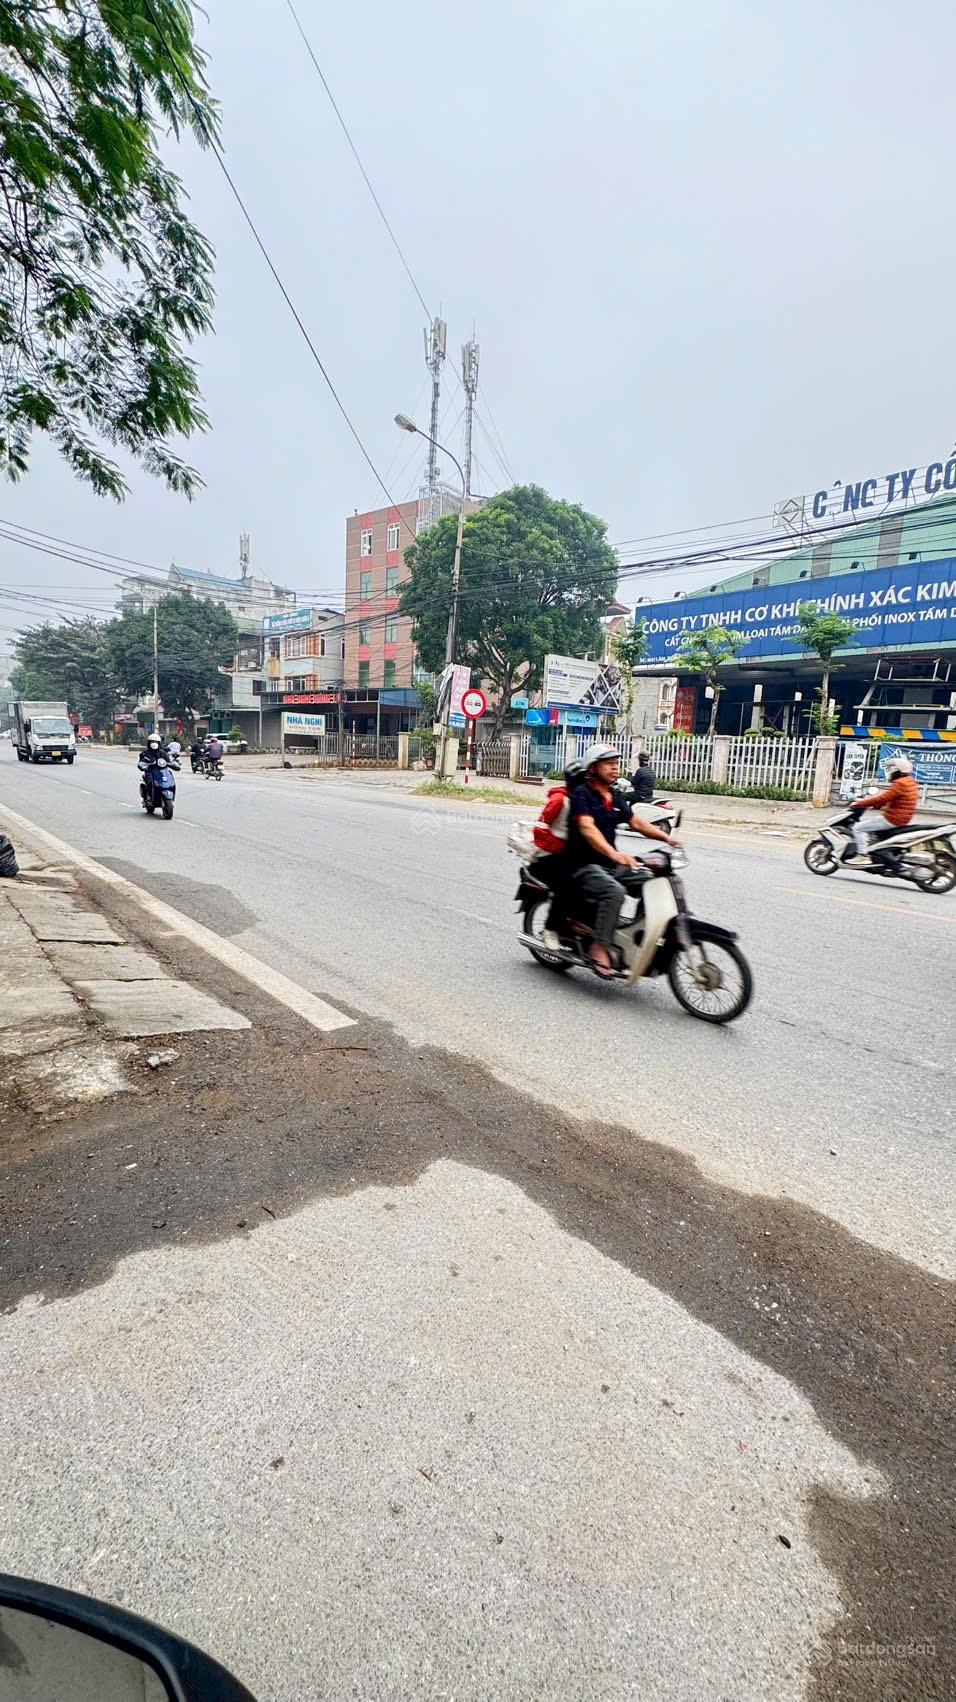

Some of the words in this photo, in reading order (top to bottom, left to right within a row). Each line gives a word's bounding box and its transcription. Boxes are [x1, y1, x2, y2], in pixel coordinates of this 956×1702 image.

[885, 468, 917, 502] TY
[641, 618, 678, 634] CÔNG
[681, 615, 699, 629] TY
[700, 610, 742, 628] TNHH
[745, 604, 769, 622] CƠ
[770, 598, 802, 619] KHÍ
[868, 585, 912, 607] XÁC
[916, 581, 956, 602] KIM
[883, 611, 916, 625] INOX
